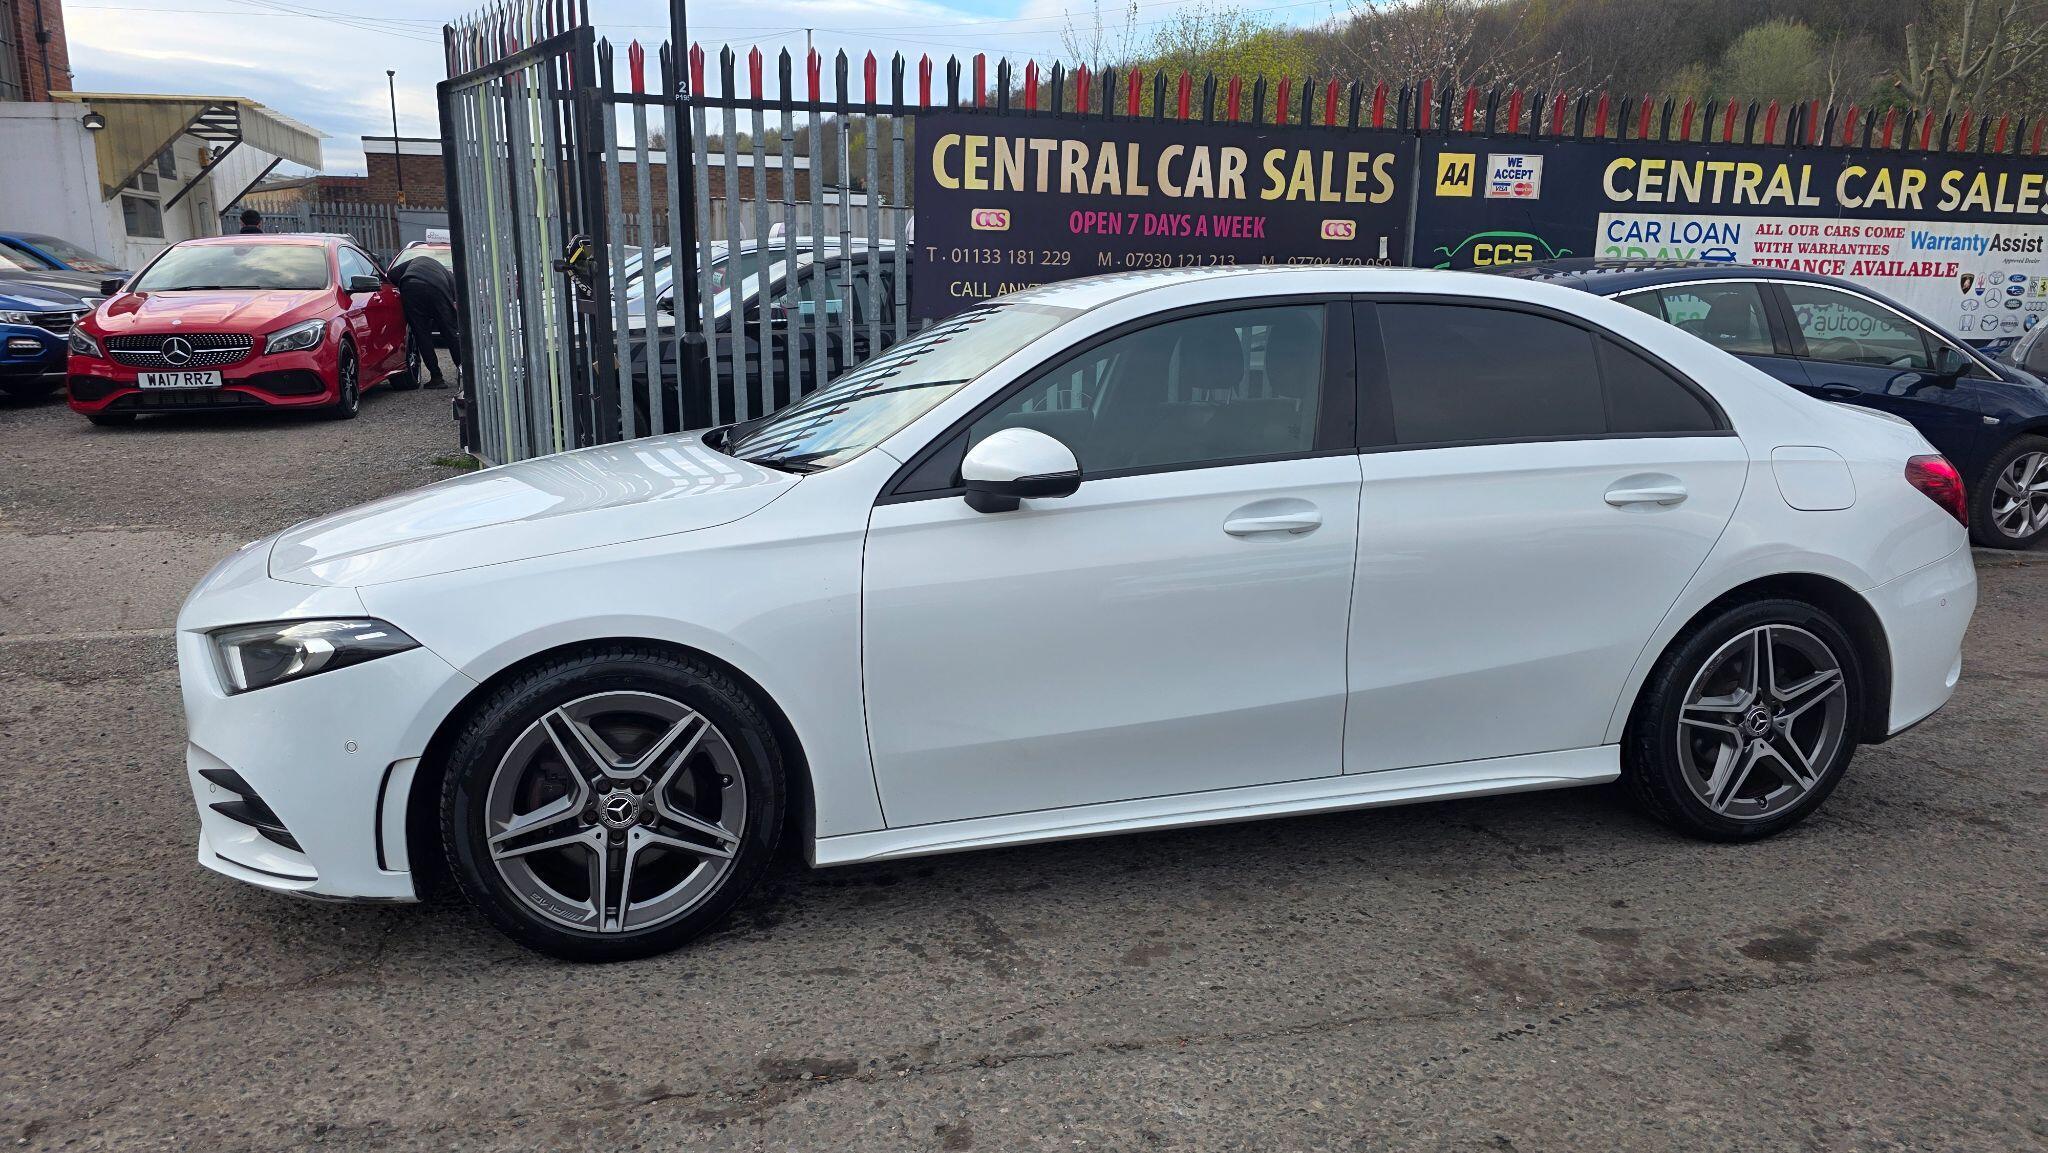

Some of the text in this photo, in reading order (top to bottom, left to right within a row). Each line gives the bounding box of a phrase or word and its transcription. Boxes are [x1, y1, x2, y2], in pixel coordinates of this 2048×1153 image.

[678, 81, 687, 93] 2
[932, 134, 1396, 204] CENTRAL CAR SALES
[1508, 157, 1523, 168] WE
[1441, 163, 1470, 186] AA
[1494, 169, 1533, 180] ACCEPT
[1602, 157, 1820, 206] CENTRAL
[1836, 165, 1927, 210] CAR
[975, 211, 1006, 228] CCS
[1069, 210, 1267, 239] OPEN 7 DAYS A WEEK
[1325, 222, 1352, 237] CCS
[1607, 219, 1741, 244] CAR LOAN
[1756, 223, 1906, 239] ALL OUR CARS COME
[951, 248, 1001, 264] 01133
[1008, 250, 1034, 265] 181
[1040, 250, 1071, 266] 229
[1473, 243, 1533, 266] CCS
[1754, 241, 1890, 256] WITH WARRANTIES
[1125, 252, 1172, 268] 07930
[1178, 254, 1202, 267] 121
[1209, 254, 1236, 266] 213
[1849, 260, 1960, 278] AVAILABLE
[950, 281, 991, 298] CALL
[147, 372, 214, 386] WA17 RRZ
